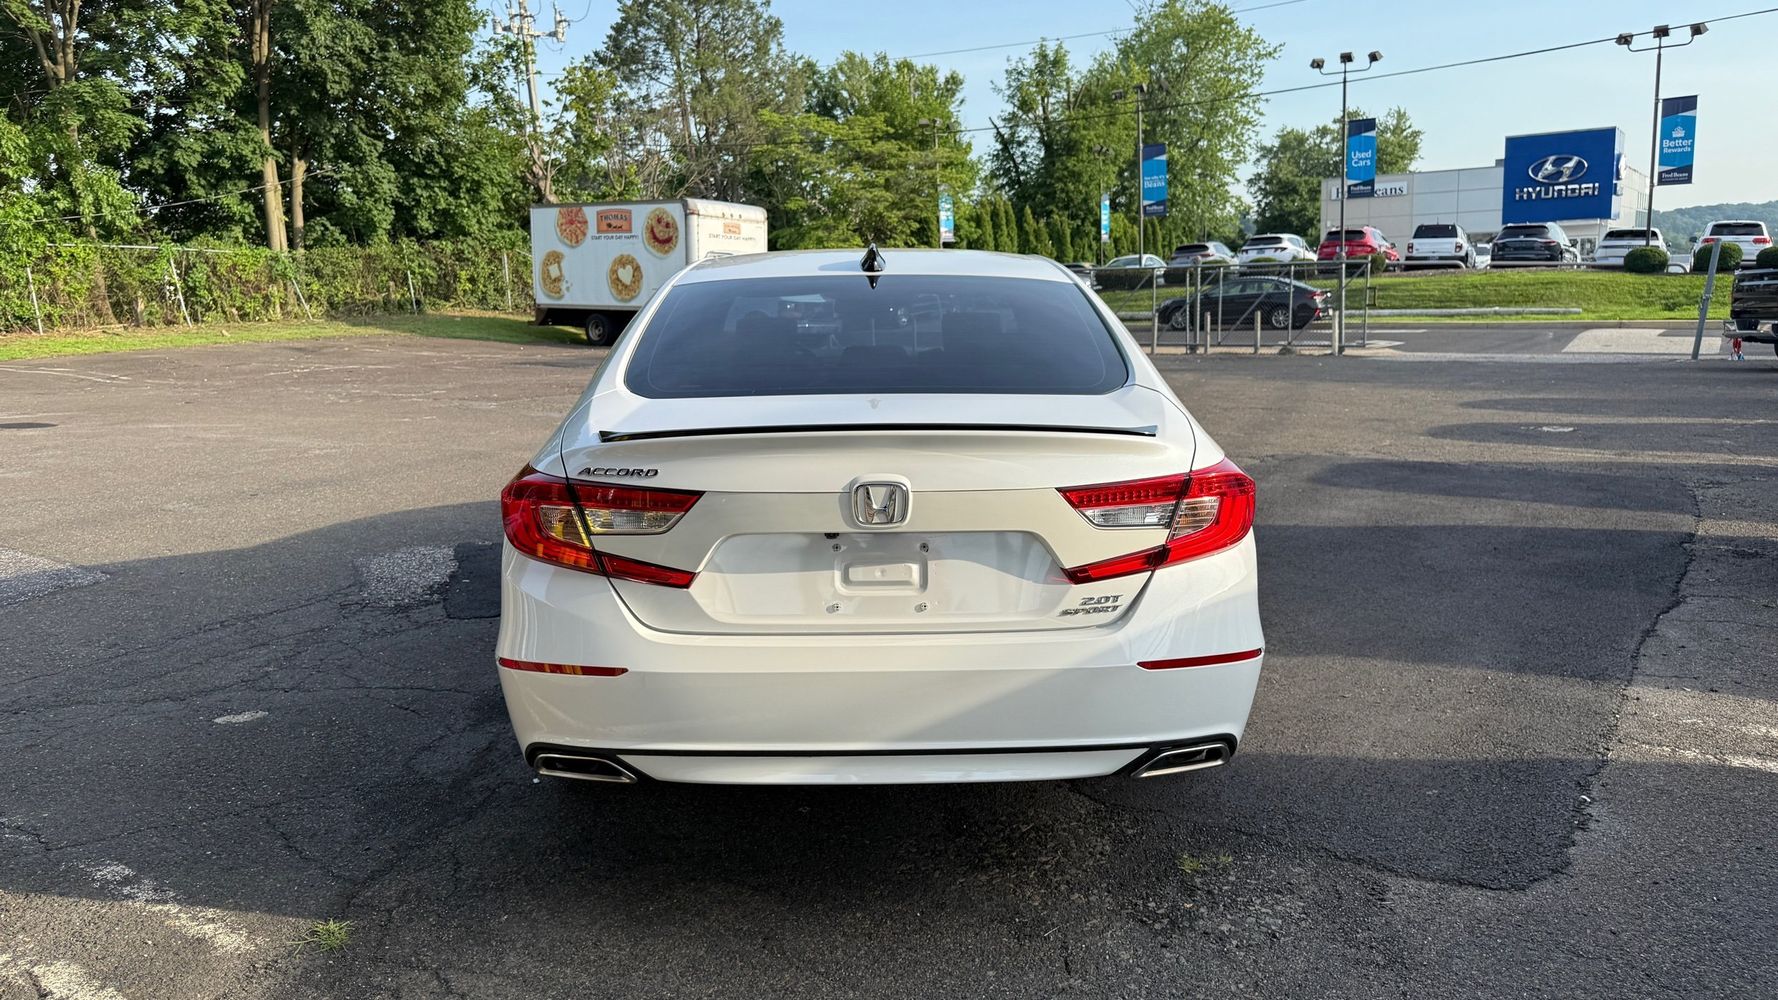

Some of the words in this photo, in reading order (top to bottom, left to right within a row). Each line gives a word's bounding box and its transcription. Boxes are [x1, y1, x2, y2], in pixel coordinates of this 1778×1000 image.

[1662, 139, 1693, 147] Better
[1351, 150, 1372, 159] Used
[1351, 159, 1371, 167] Cars
[1374, 185, 1404, 196] eans
[1515, 183, 1599, 200] HYUNDAI
[578, 467, 659, 478] ACCORD
[1057, 605, 1122, 617] SPORT
